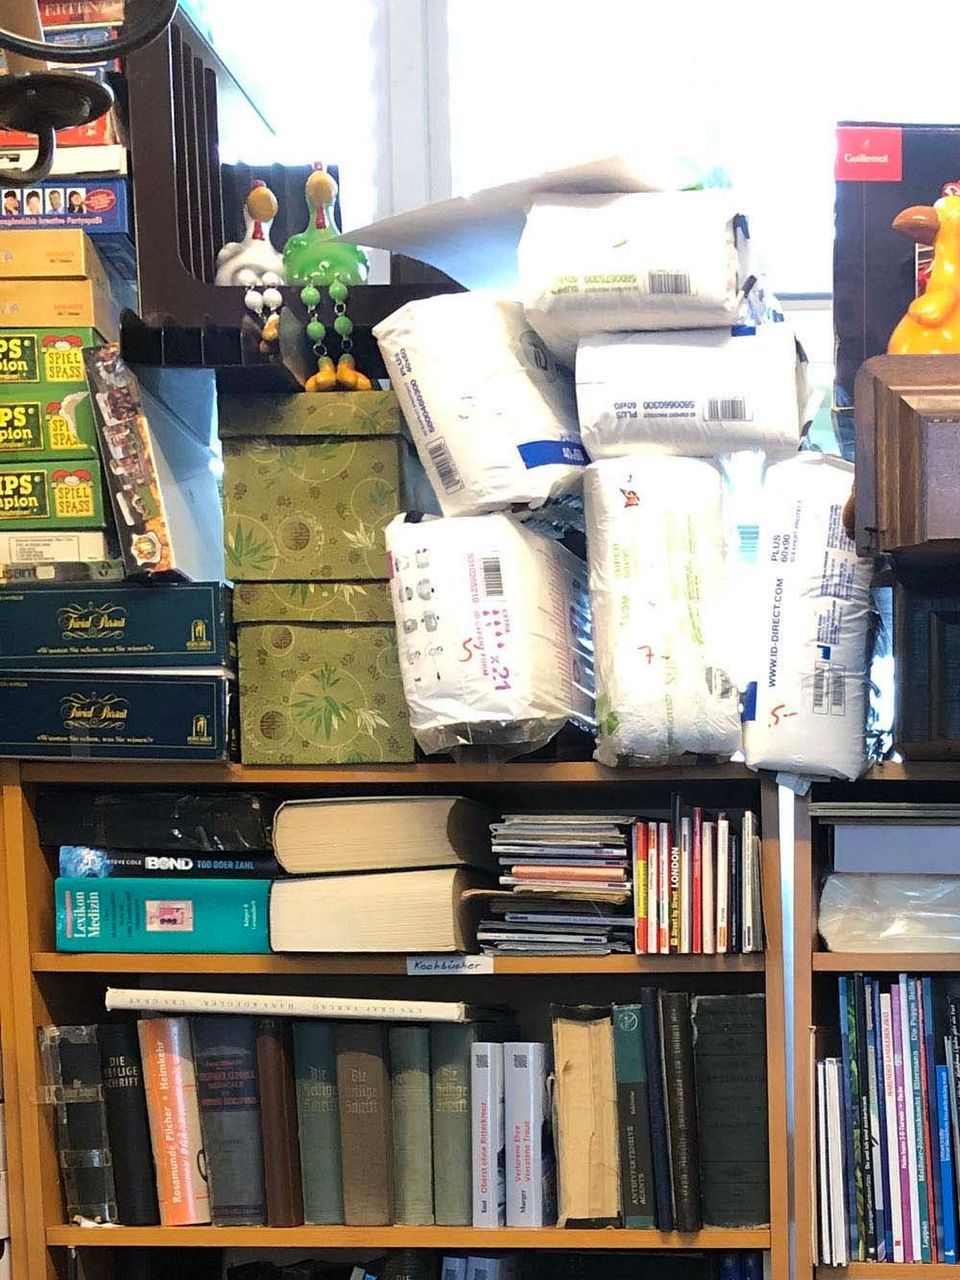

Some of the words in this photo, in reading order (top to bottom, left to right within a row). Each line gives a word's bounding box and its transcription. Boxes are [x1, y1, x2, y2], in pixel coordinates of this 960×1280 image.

[49, 353, 81, 364] SPIEL
[49, 366, 82, 378] SPASS
[615, 410, 638, 420] PLUS
[58, 487, 90, 500] SPIEL
[58, 501, 91, 514] SPASS
[770, 535, 781, 562] PLUS
[780, 534, 791, 562] 60x90
[768, 578, 784, 688] WWW.ID-DIRECT.COM
[145, 856, 194, 871] BOND
[670, 847, 679, 888] LONDON
[73, 891, 87, 938] Lexikon
[87, 891, 101, 938] Medizin
[109, 1056, 125, 1067] DIE
[156, 1039, 169, 1091] Heimkehr
[164, 1104, 176, 1142] Pilcher
[479, 1101, 487, 1143] Ritterkreuz
[479, 1146, 487, 1164] ohne
[512, 1144, 522, 1182] Verlorene
[170, 1143, 182, 1204] Rosamunde
